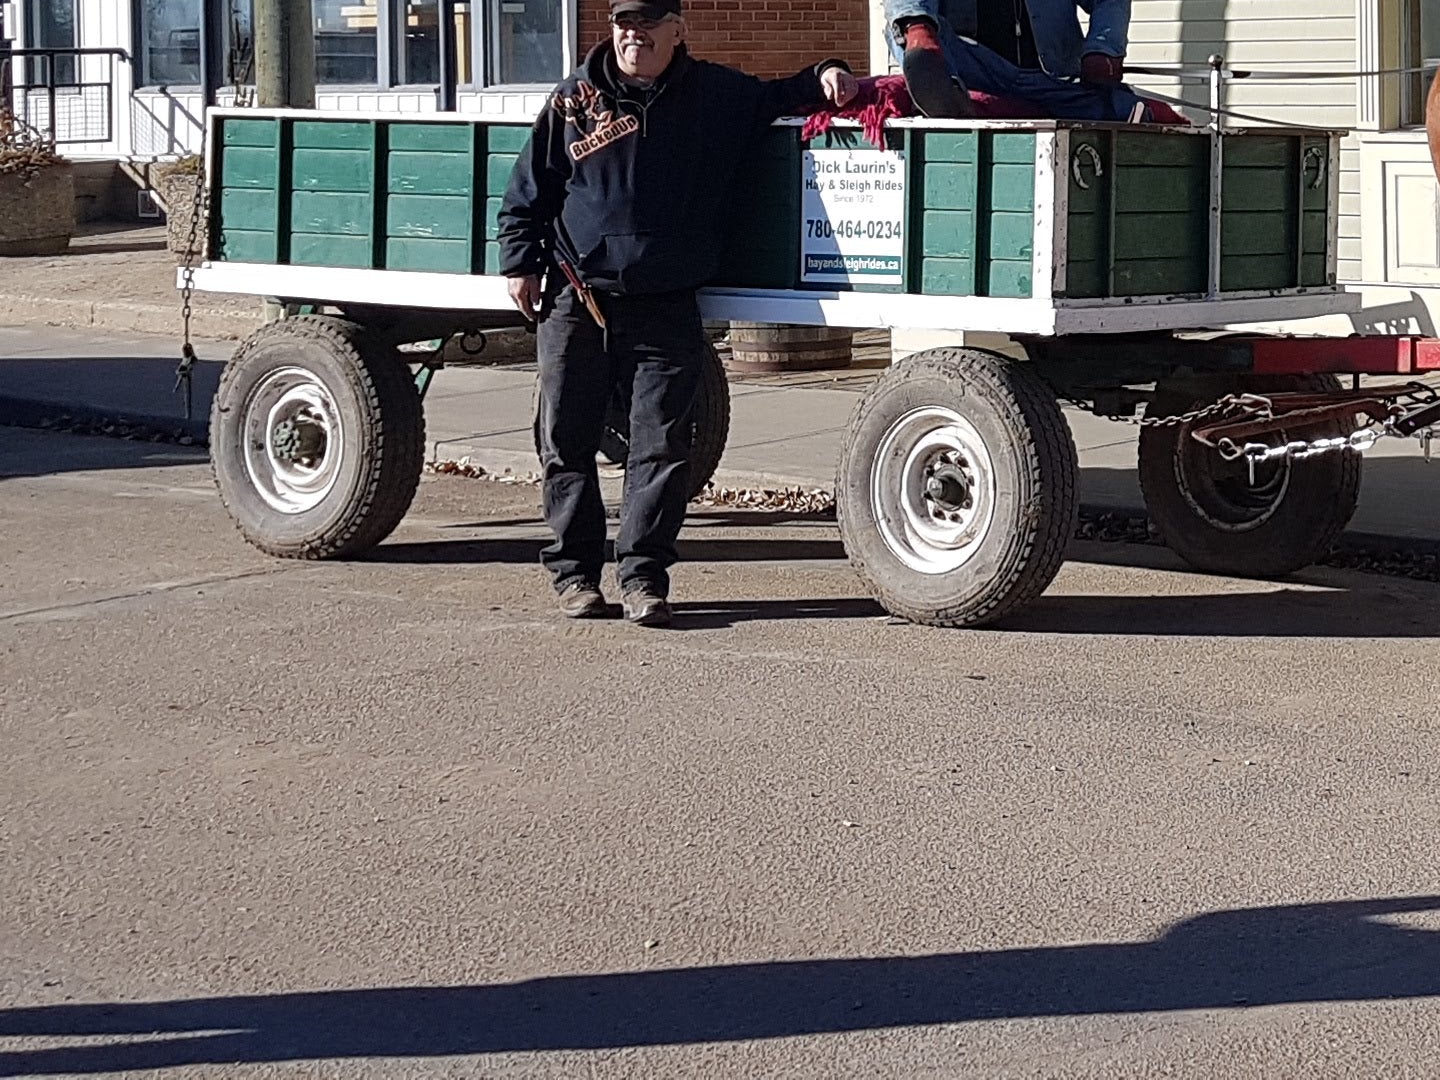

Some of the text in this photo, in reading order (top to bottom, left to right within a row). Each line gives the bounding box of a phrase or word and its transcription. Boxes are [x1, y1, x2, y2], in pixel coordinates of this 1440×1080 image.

[813, 160, 896, 174] Dick Laurin's
[805, 179, 903, 193] Hay & Sleigh Rides
[806, 219, 902, 239] 780-464-0234
